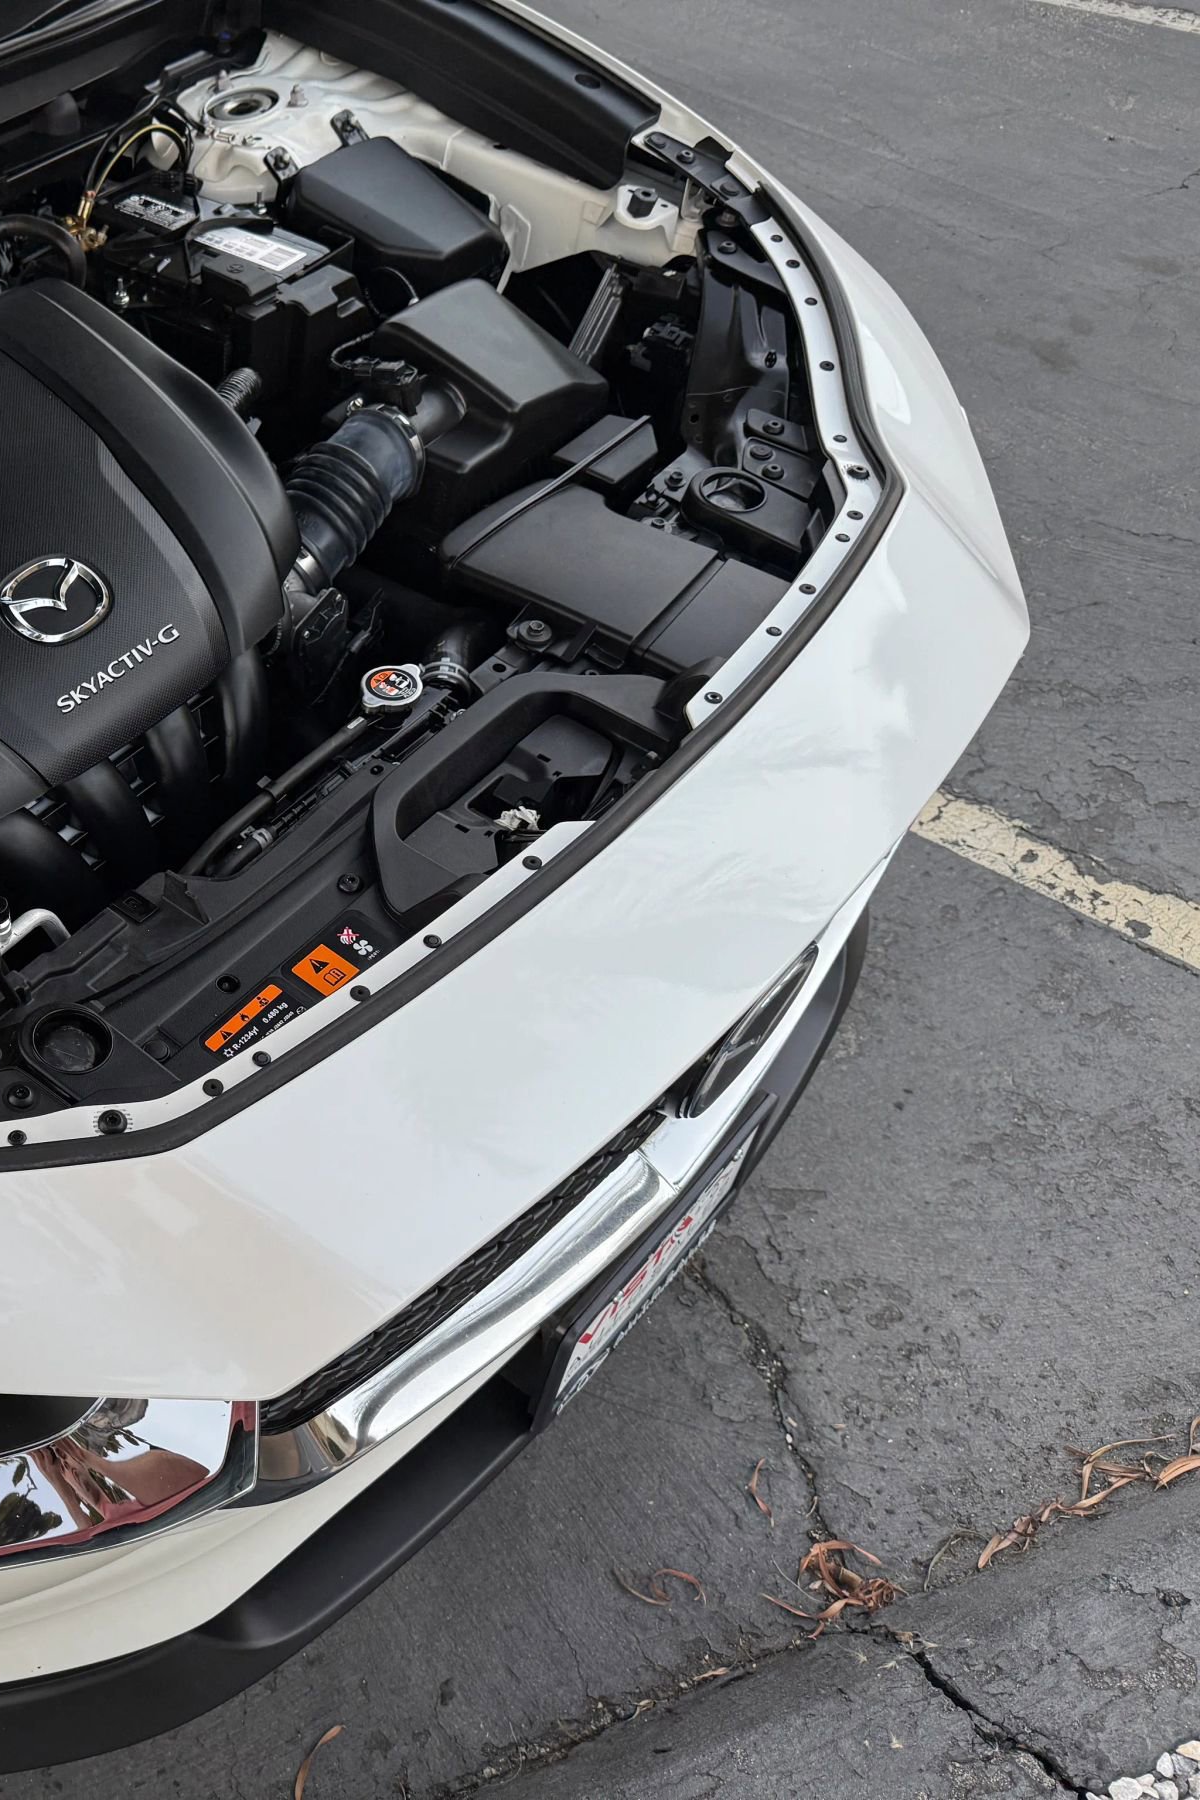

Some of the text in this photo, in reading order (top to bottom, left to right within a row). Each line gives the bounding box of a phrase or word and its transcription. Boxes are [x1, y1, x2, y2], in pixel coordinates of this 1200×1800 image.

[56, 623, 181, 714] SKYACTIV-G
[232, 1025, 260, 1051] R-1234yf
[276, 1002, 289, 1011] kg
